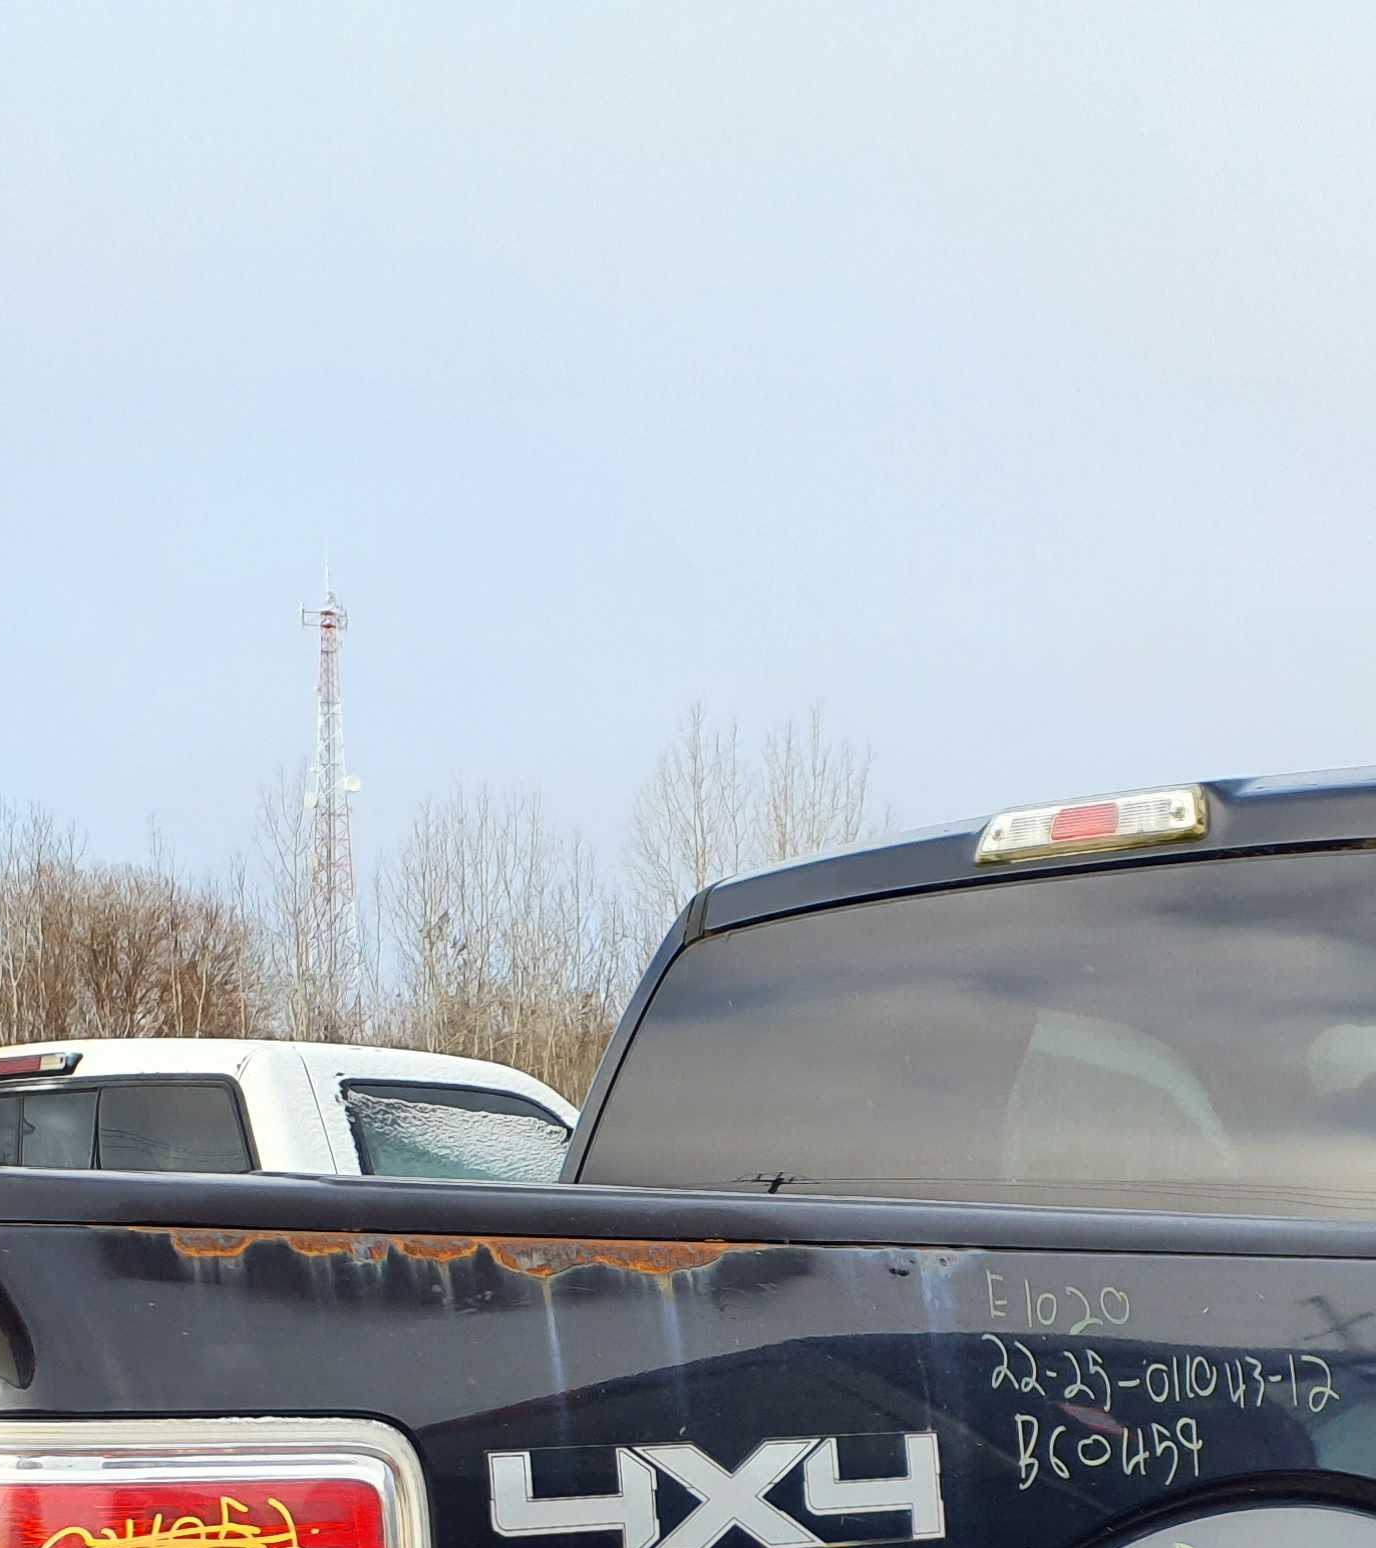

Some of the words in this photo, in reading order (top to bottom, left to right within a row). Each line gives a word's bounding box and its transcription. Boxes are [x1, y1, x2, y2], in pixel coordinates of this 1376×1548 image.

[986, 1269, 1130, 1335] E1020
[982, 1333, 1340, 1414] 22-25-011043-12
[1015, 1414, 1204, 1491] B60459
